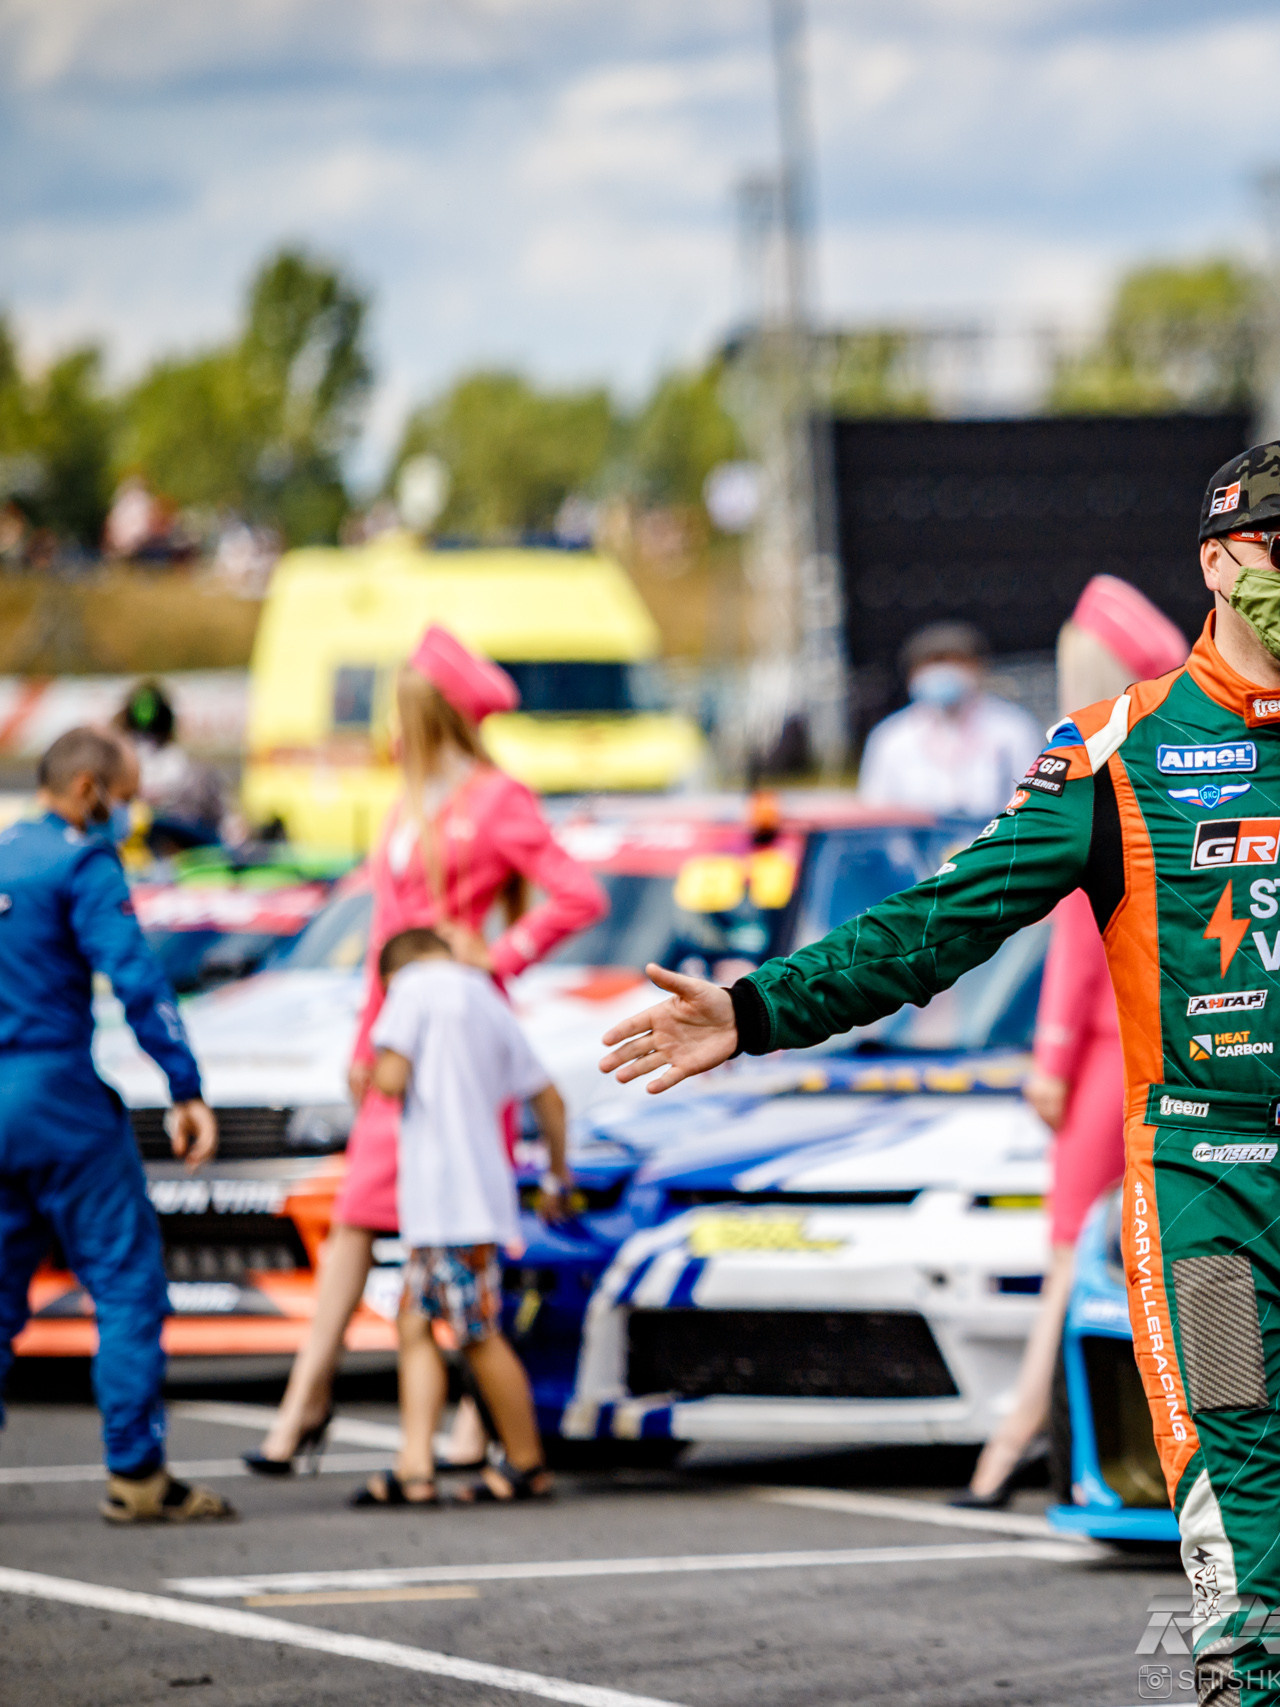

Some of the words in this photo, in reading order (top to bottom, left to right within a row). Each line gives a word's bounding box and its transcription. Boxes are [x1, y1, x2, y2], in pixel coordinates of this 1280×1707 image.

[1210, 492, 1238, 511] GR
[1038, 757, 1067, 775] GP
[1161, 748, 1251, 768] AIMOL
[1032, 778, 1061, 791] SERIES
[1196, 836, 1277, 864] GR
[1215, 1031, 1251, 1045] HEAT
[1216, 1042, 1273, 1057] CARBON
[1160, 1095, 1209, 1117] freem
[1212, 1148, 1276, 1160] WISEFAB
[1134, 1181, 1187, 1442] #CARVILLERACING
